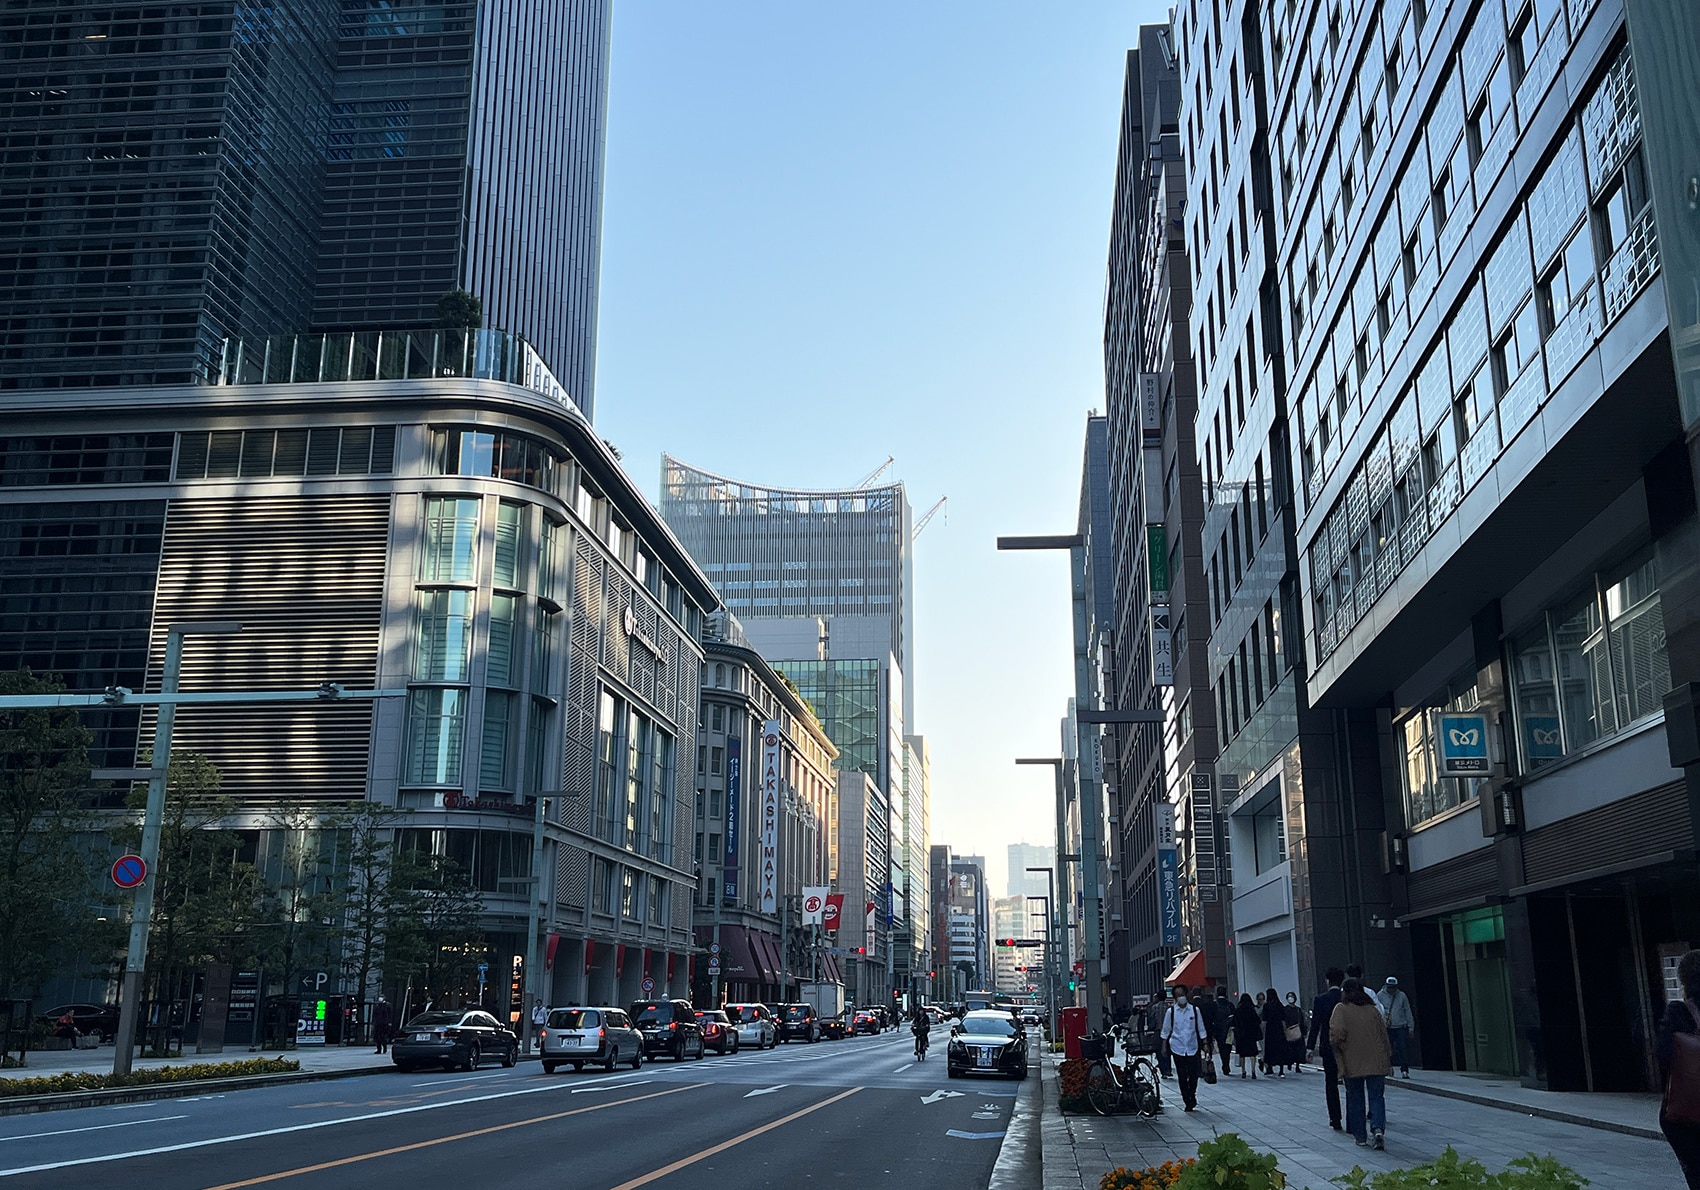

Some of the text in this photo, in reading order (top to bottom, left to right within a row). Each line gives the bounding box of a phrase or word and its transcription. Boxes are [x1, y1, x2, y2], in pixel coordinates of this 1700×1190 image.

[1155, 640, 1171, 677] 共生
[764, 752, 775, 899] TAKASHIMAYA
[1163, 871, 1176, 929] 東急リバブル
[1166, 934, 1177, 942] 2F
[315, 972, 328, 991] P
